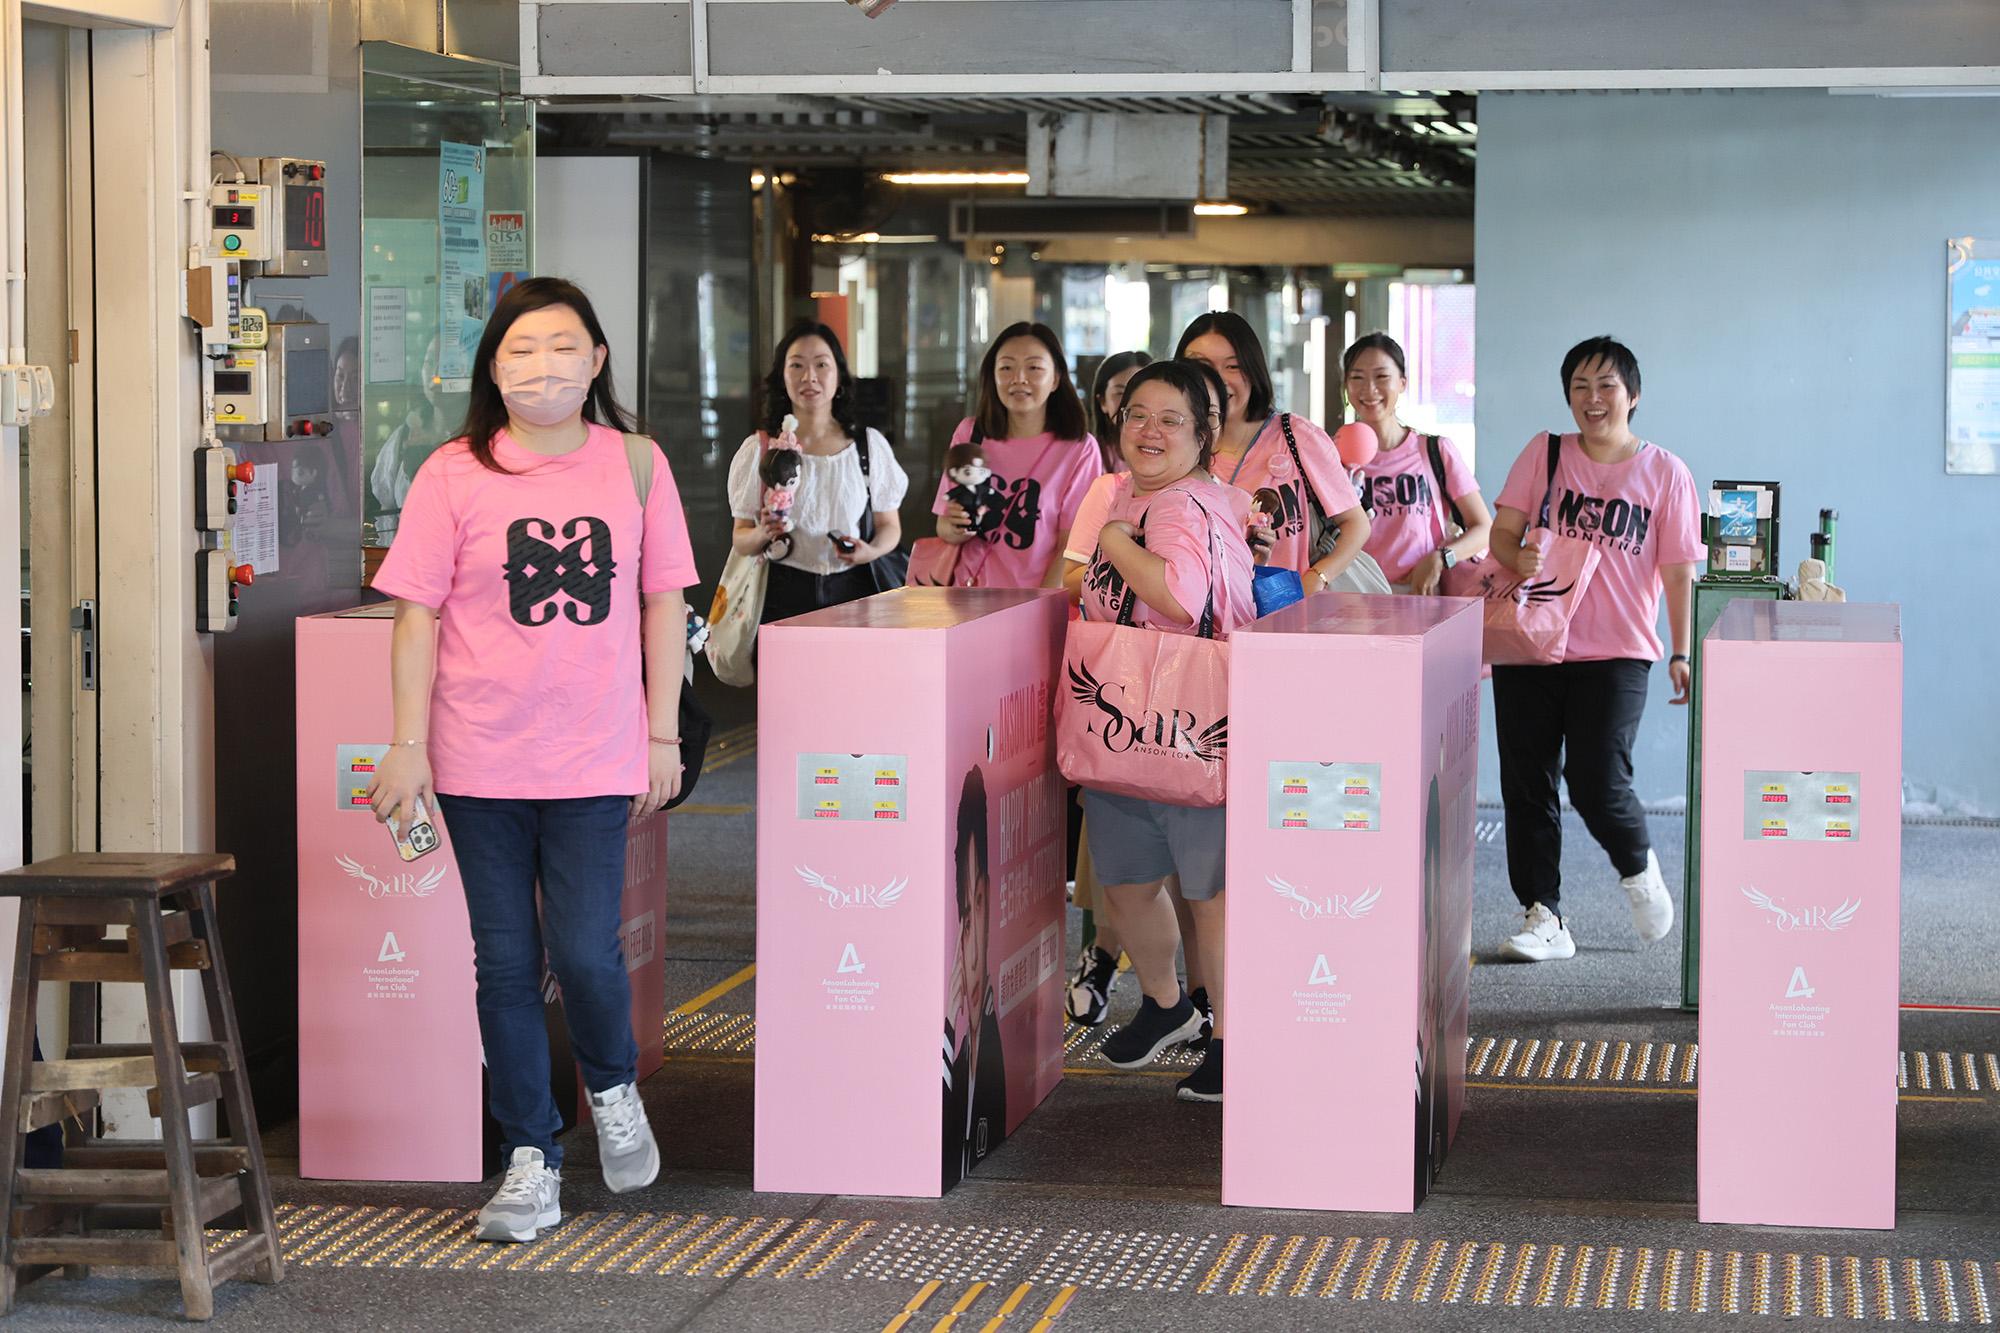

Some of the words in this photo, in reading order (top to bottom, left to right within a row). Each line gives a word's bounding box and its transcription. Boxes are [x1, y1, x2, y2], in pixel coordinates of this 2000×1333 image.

[231, 212, 239, 223] 3
[305, 191, 324, 247] 10
[1557, 487, 1652, 546] NSON
[1133, 745, 1171, 757] ANSON
[390, 983, 407, 991] Club
[849, 995, 866, 1003] Club
[1321, 1007, 1338, 1015] Club
[1798, 1021, 1816, 1029] Club
